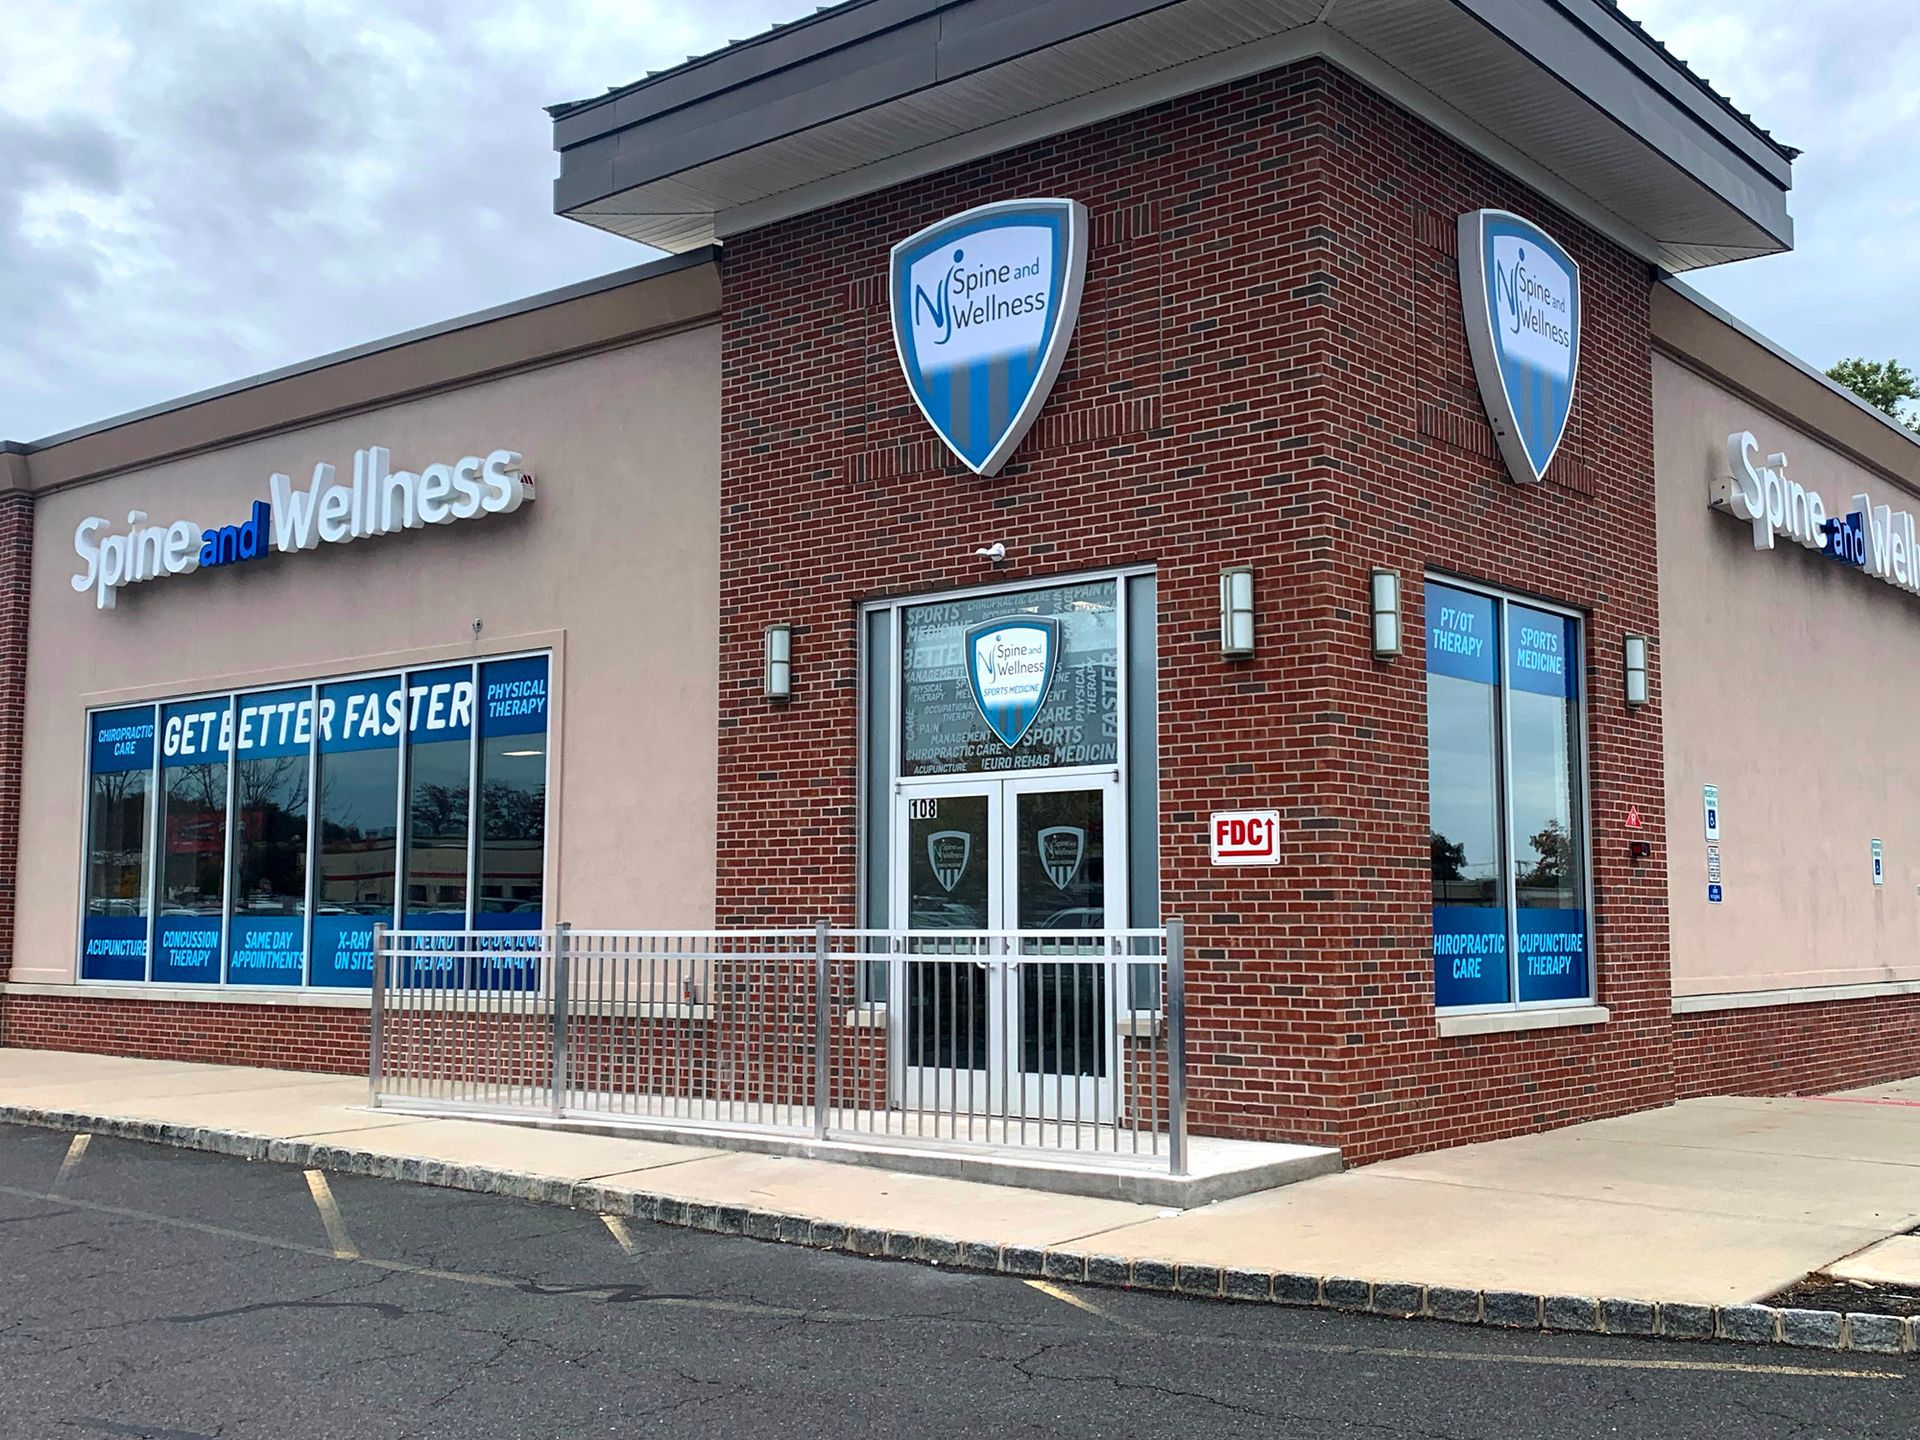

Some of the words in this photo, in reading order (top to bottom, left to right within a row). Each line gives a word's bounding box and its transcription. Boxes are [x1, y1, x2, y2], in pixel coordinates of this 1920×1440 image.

[953, 263, 1010, 298] Spine
[1014, 257, 1039, 281] and
[1518, 267, 1550, 304] Spine
[1552, 296, 1566, 313] and
[952, 291, 1045, 329] Wellness
[1520, 301, 1570, 348] Wellness
[1728, 431, 1827, 550] Spine
[1823, 511, 1866, 567] and
[1853, 494, 1920, 594] Well
[70, 510, 201, 610] Spine
[199, 500, 271, 568] and
[269, 446, 523, 553] Wellness
[906, 604, 960, 625] SPORTS
[1440, 607, 1474, 633] PT/OT
[1432, 629, 1483, 658] THERAPY
[1520, 627, 1557, 653] SPORTS
[997, 644, 1027, 661] Spine
[1028, 644, 1042, 654] and
[1517, 648, 1562, 675] MEDICINE
[997, 660, 1045, 676] Wellness
[487, 679, 546, 700] PHYSICAL
[984, 687, 1008, 697] SPORTS
[1009, 684, 1040, 695] MEDICINE
[1075, 662, 1085, 722] PHYSICAL
[1086, 656, 1097, 715] THERAPY
[489, 697, 545, 718] THERAPY
[1037, 706, 1073, 724] CARE
[163, 711, 216, 757] GET
[218, 698, 336, 752] BETTER
[343, 681, 473, 740] FASTER
[98, 724, 154, 743] CHIROPRACTIC
[1023, 725, 1082, 747] SPORTS
[114, 742, 135, 756] CARE
[906, 745, 975, 761] CHIROPRACTIC
[976, 743, 1003, 756] CARE
[1054, 743, 1117, 763] MEDICIN
[913, 763, 968, 775] ACUPUNCTURE
[1014, 754, 1050, 768] REHAB
[911, 799, 936, 818] 108
[1217, 818, 1262, 846] FDC
[87, 939, 148, 956] ACUPUNCTURE
[163, 931, 218, 949] CONCUSSION
[245, 931, 272, 949] SAME
[272, 932, 293, 950] DAY
[338, 931, 372, 949] X-RAY
[1433, 933, 1505, 955] HIROPRACTIC
[1517, 933, 1583, 953] CUPUNCTURE
[169, 949, 210, 967] THERAPY
[231, 951, 304, 969] APPOINTMENTS
[334, 952, 350, 970] ON
[351, 951, 374, 970] SITE
[1453, 957, 1482, 979] CARE
[1527, 956, 1572, 976] THERAPY
